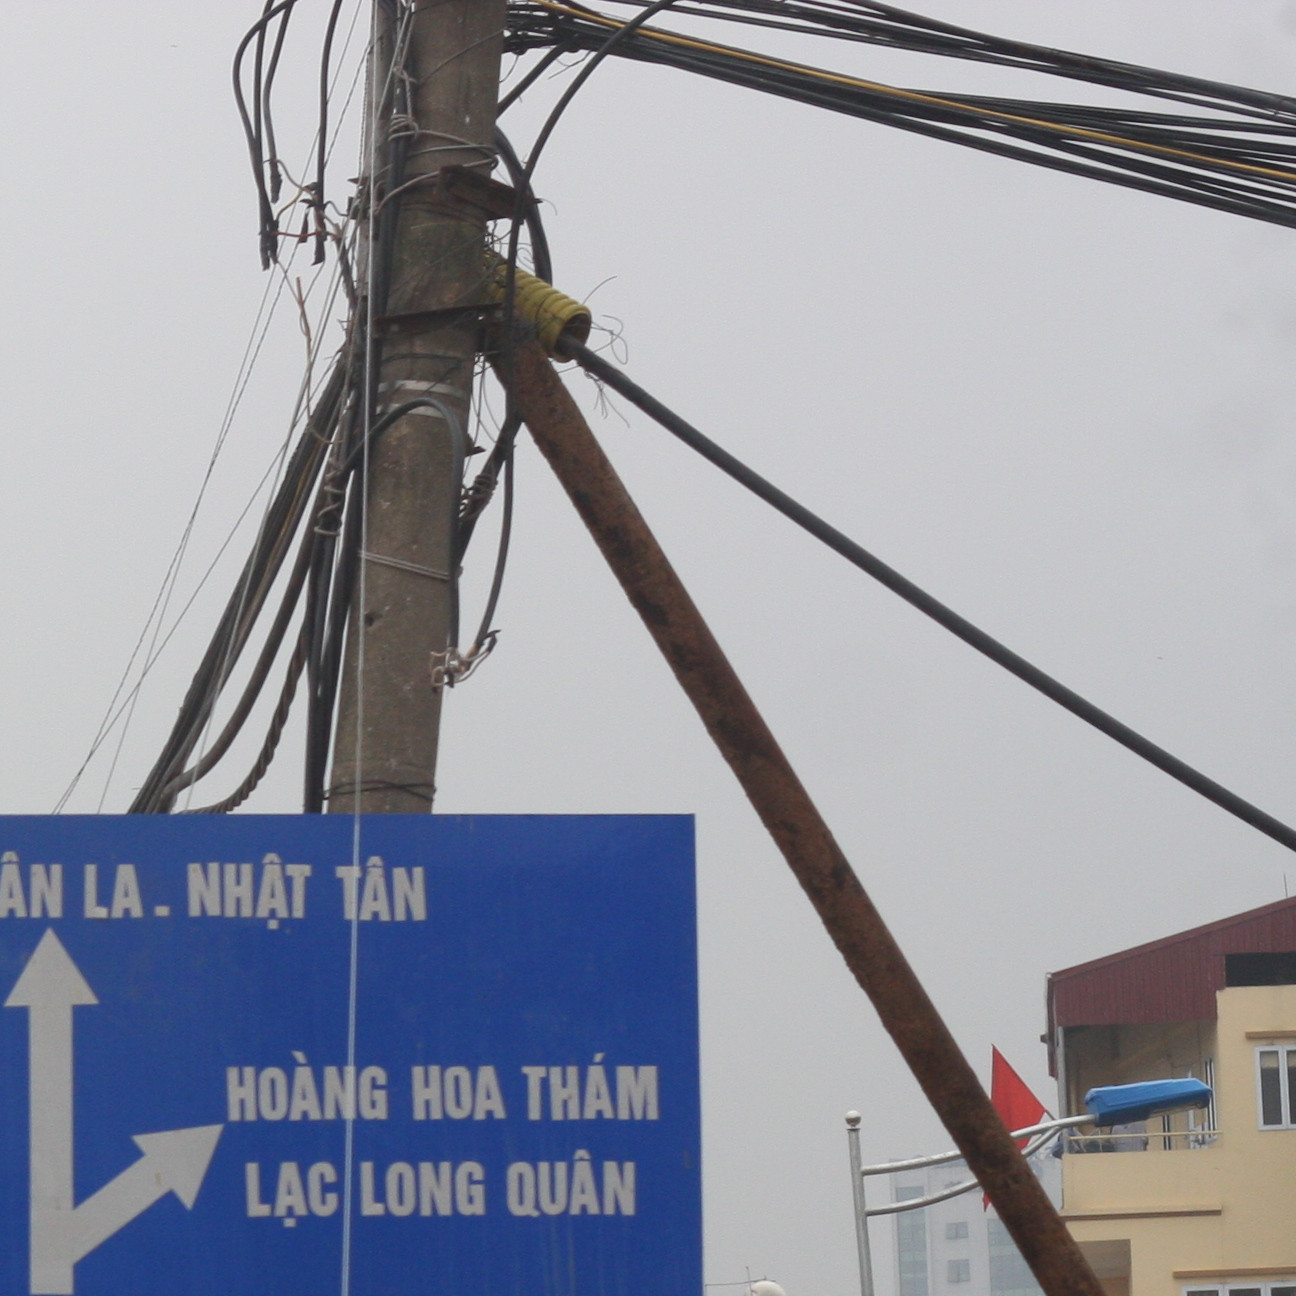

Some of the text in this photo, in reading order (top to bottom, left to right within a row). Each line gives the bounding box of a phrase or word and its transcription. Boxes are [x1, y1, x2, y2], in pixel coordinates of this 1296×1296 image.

[188, 853, 311, 929] NHẬT
[336, 856, 426, 921] TÂN
[227, 1052, 659, 1121] HOÀNG HOA THÁM
[246, 1150, 635, 1228] LẠC LONG QUÂN
